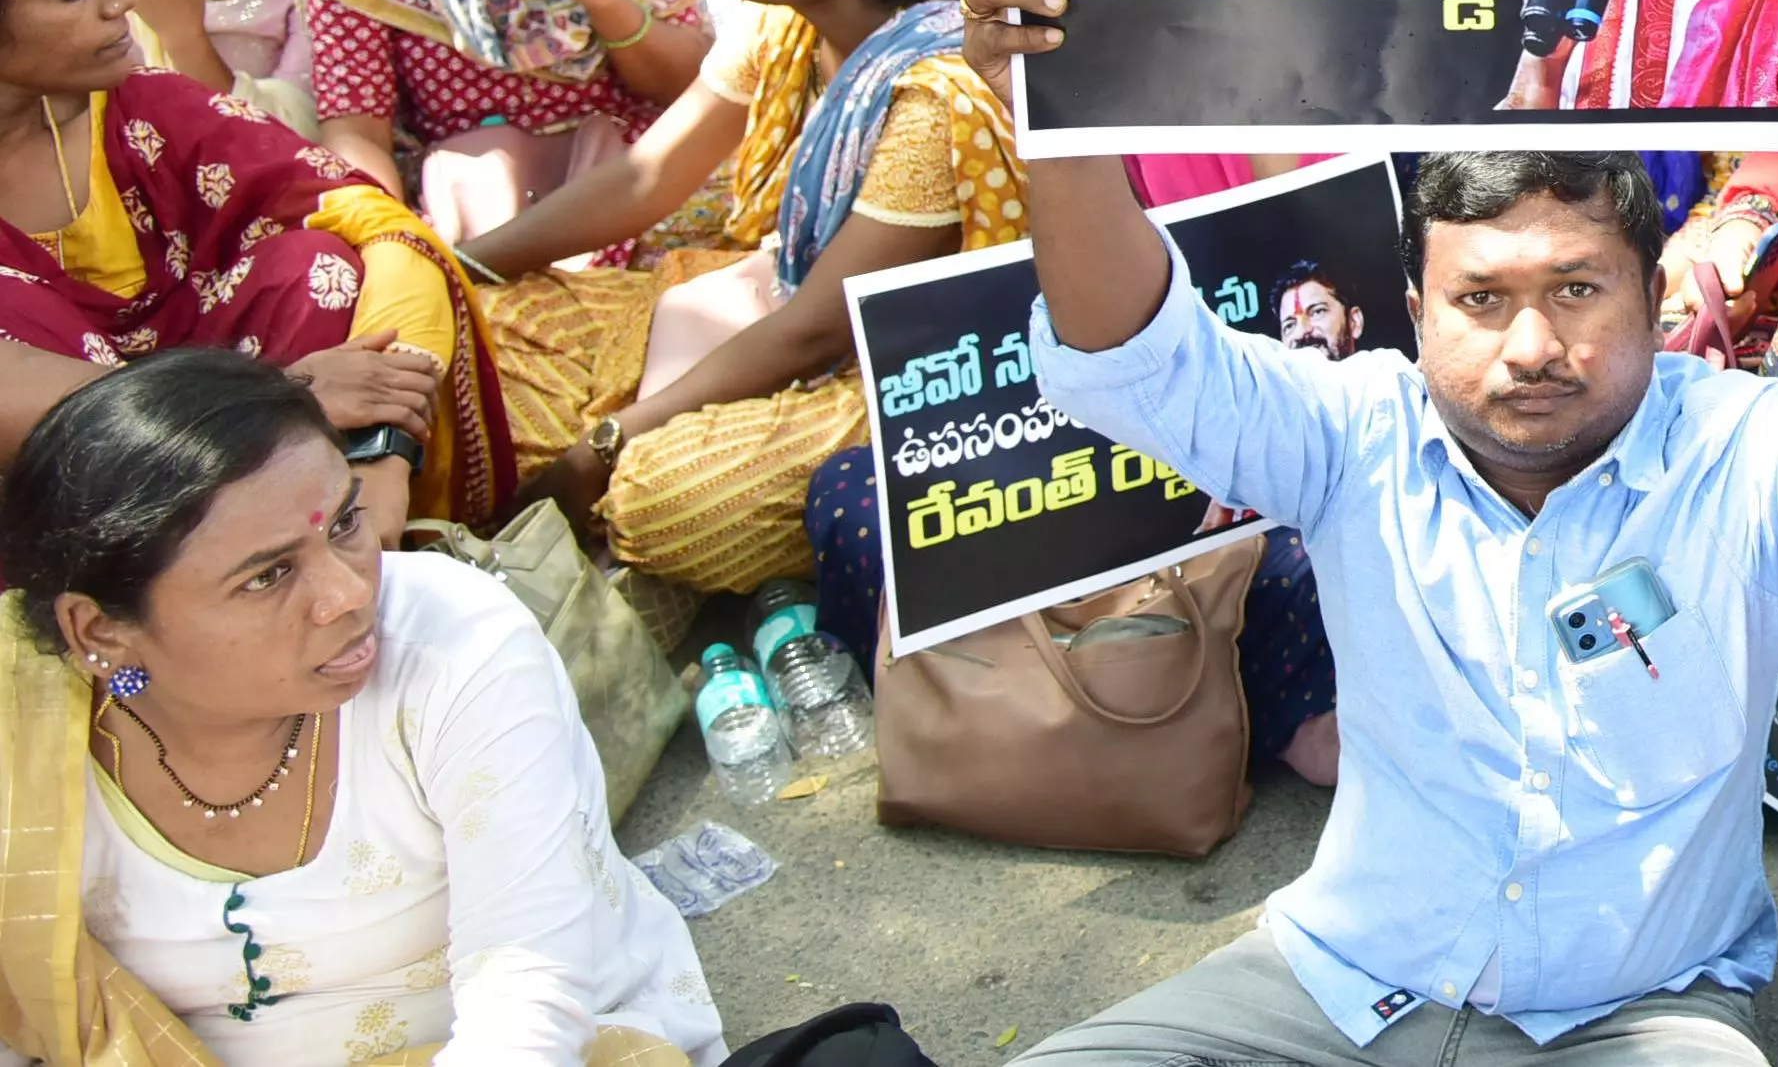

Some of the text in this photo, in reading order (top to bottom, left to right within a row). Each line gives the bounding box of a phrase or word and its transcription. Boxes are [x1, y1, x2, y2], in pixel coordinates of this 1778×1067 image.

[1214, 275, 1261, 325] ను
[880, 332, 983, 418] జీవో
[891, 396, 1088, 478] ఉపసంహ
[906, 445, 1098, 550] రేవంత్
